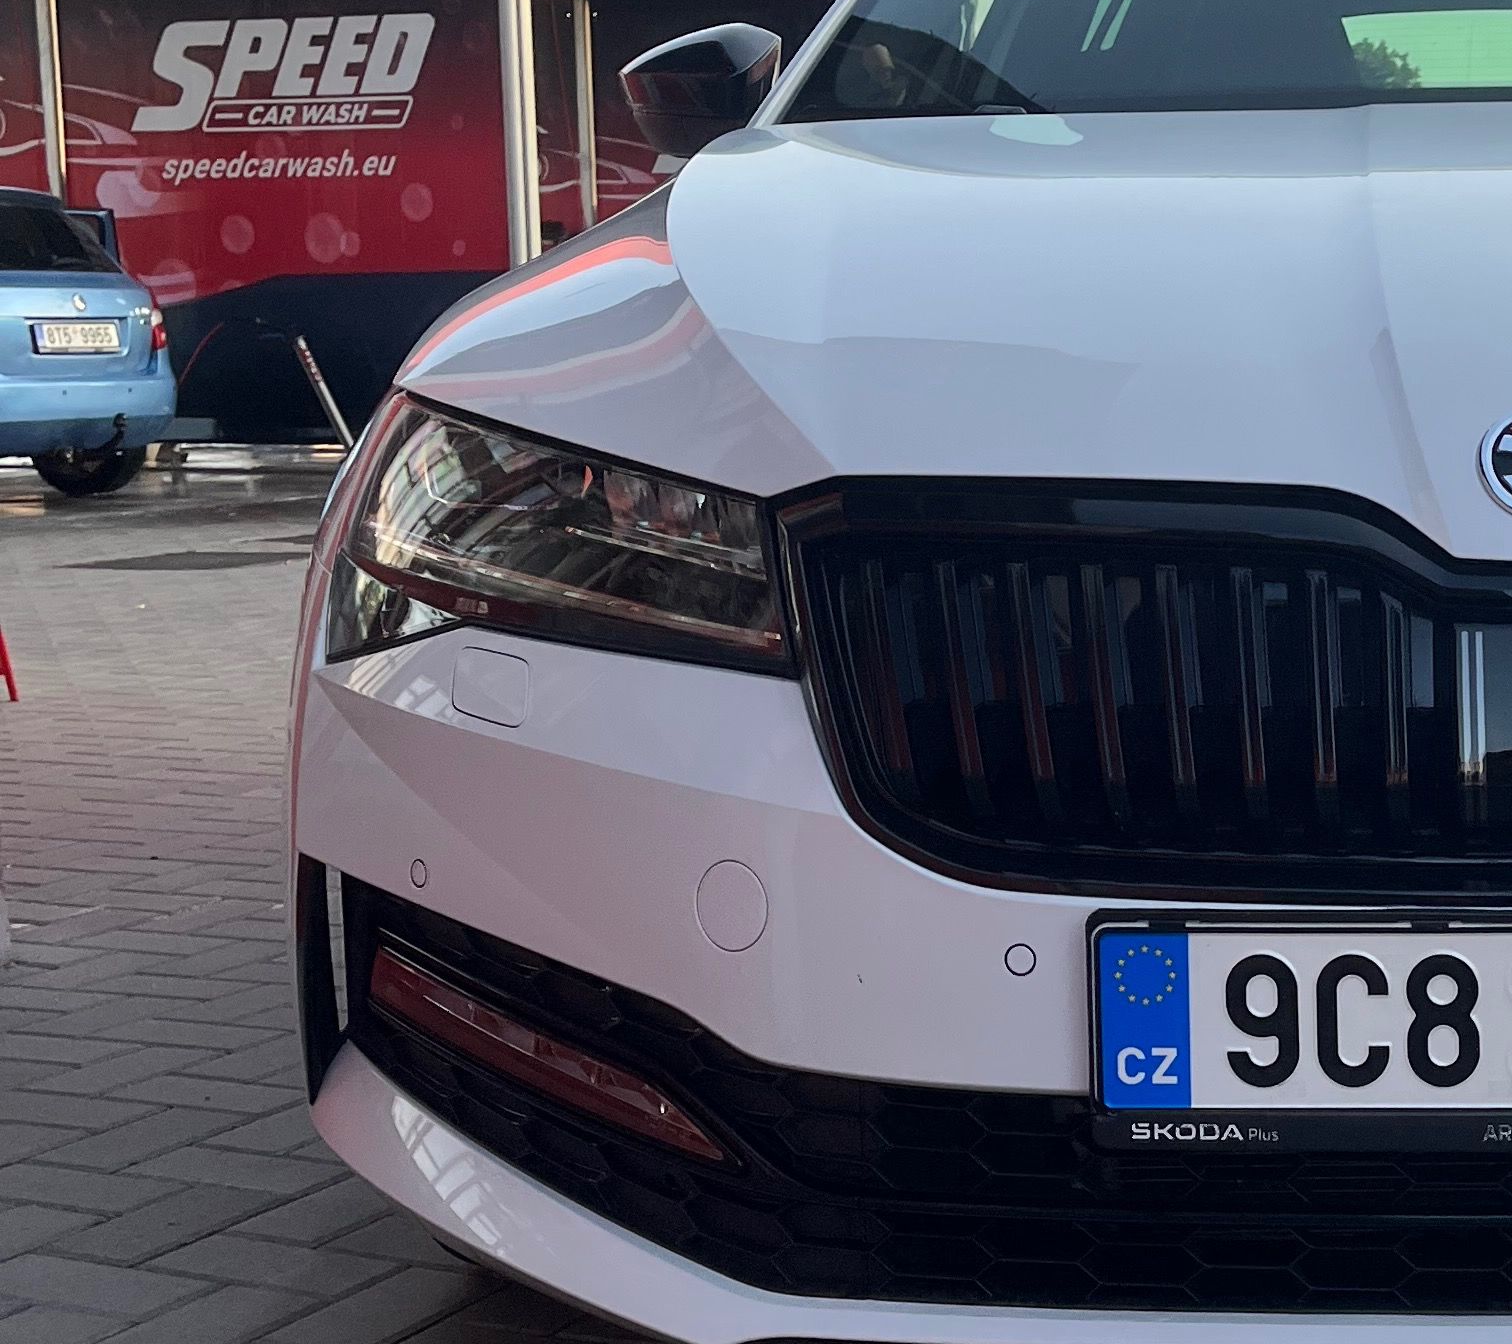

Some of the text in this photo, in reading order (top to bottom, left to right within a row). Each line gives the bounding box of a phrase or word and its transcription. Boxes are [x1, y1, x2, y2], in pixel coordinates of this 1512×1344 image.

[131, 13, 436, 132] SPEED
[247, 104, 369, 125] CAR WASH
[162, 149, 397, 186] speedcarwash.eu
[1225, 953, 1481, 1088] 9C8
[1117, 1047, 1179, 1085] CZ
[1248, 1128, 1280, 1142] Plus
[1483, 1124, 1512, 1141] AR
